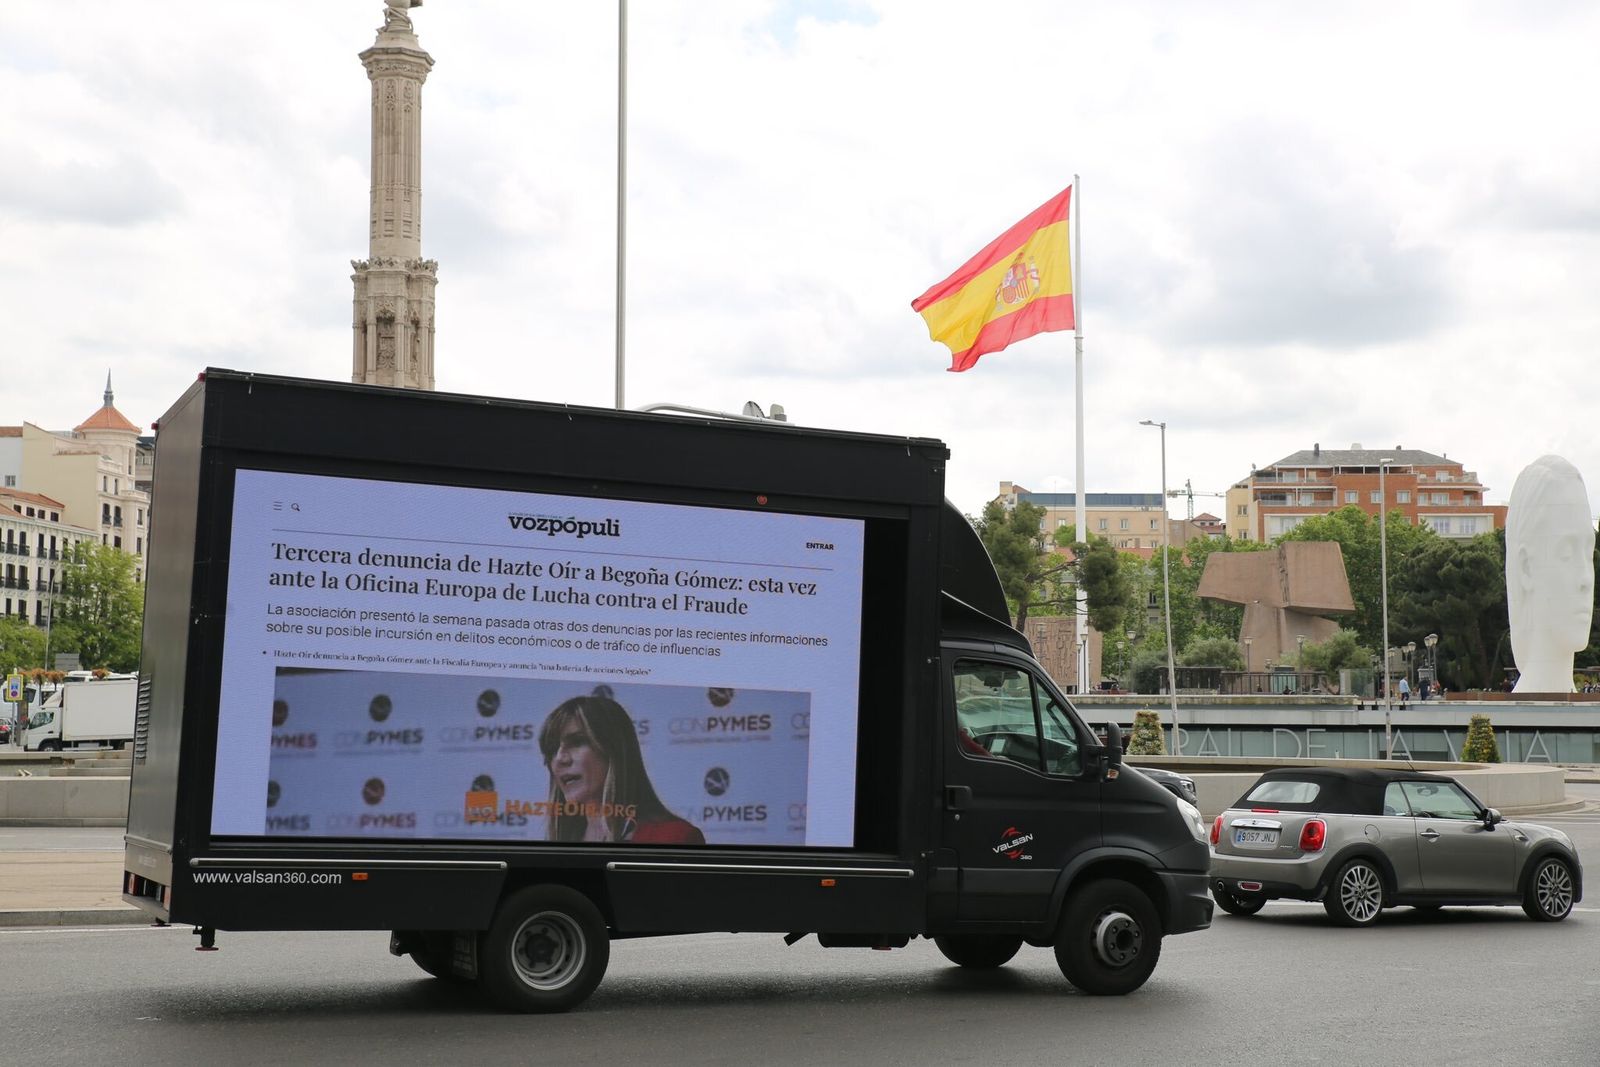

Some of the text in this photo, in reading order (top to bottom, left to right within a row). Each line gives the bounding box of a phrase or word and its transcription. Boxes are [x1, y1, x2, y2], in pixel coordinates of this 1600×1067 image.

[507, 515, 620, 539] vozpópuli
[805, 542, 834, 551] ENTRAR
[271, 542, 817, 596] Tercera denuncia de Hazte Oír a Begoña Gómez: esta vez
[268, 570, 748, 615] ante la Oficina Europa de Lucha contra el Fraude
[265, 620, 721, 657] sobre su posible incursión en delitos económicos o de tráfico de influencias
[267, 603, 828, 646] La asociación presentó la semana pasada otras dos denuncias por las recientes informaciones
[1272, 728, 1327, 758] DE
[1242, 832, 1259, 842] 9057
[193, 870, 343, 884] www.valsan360.com
